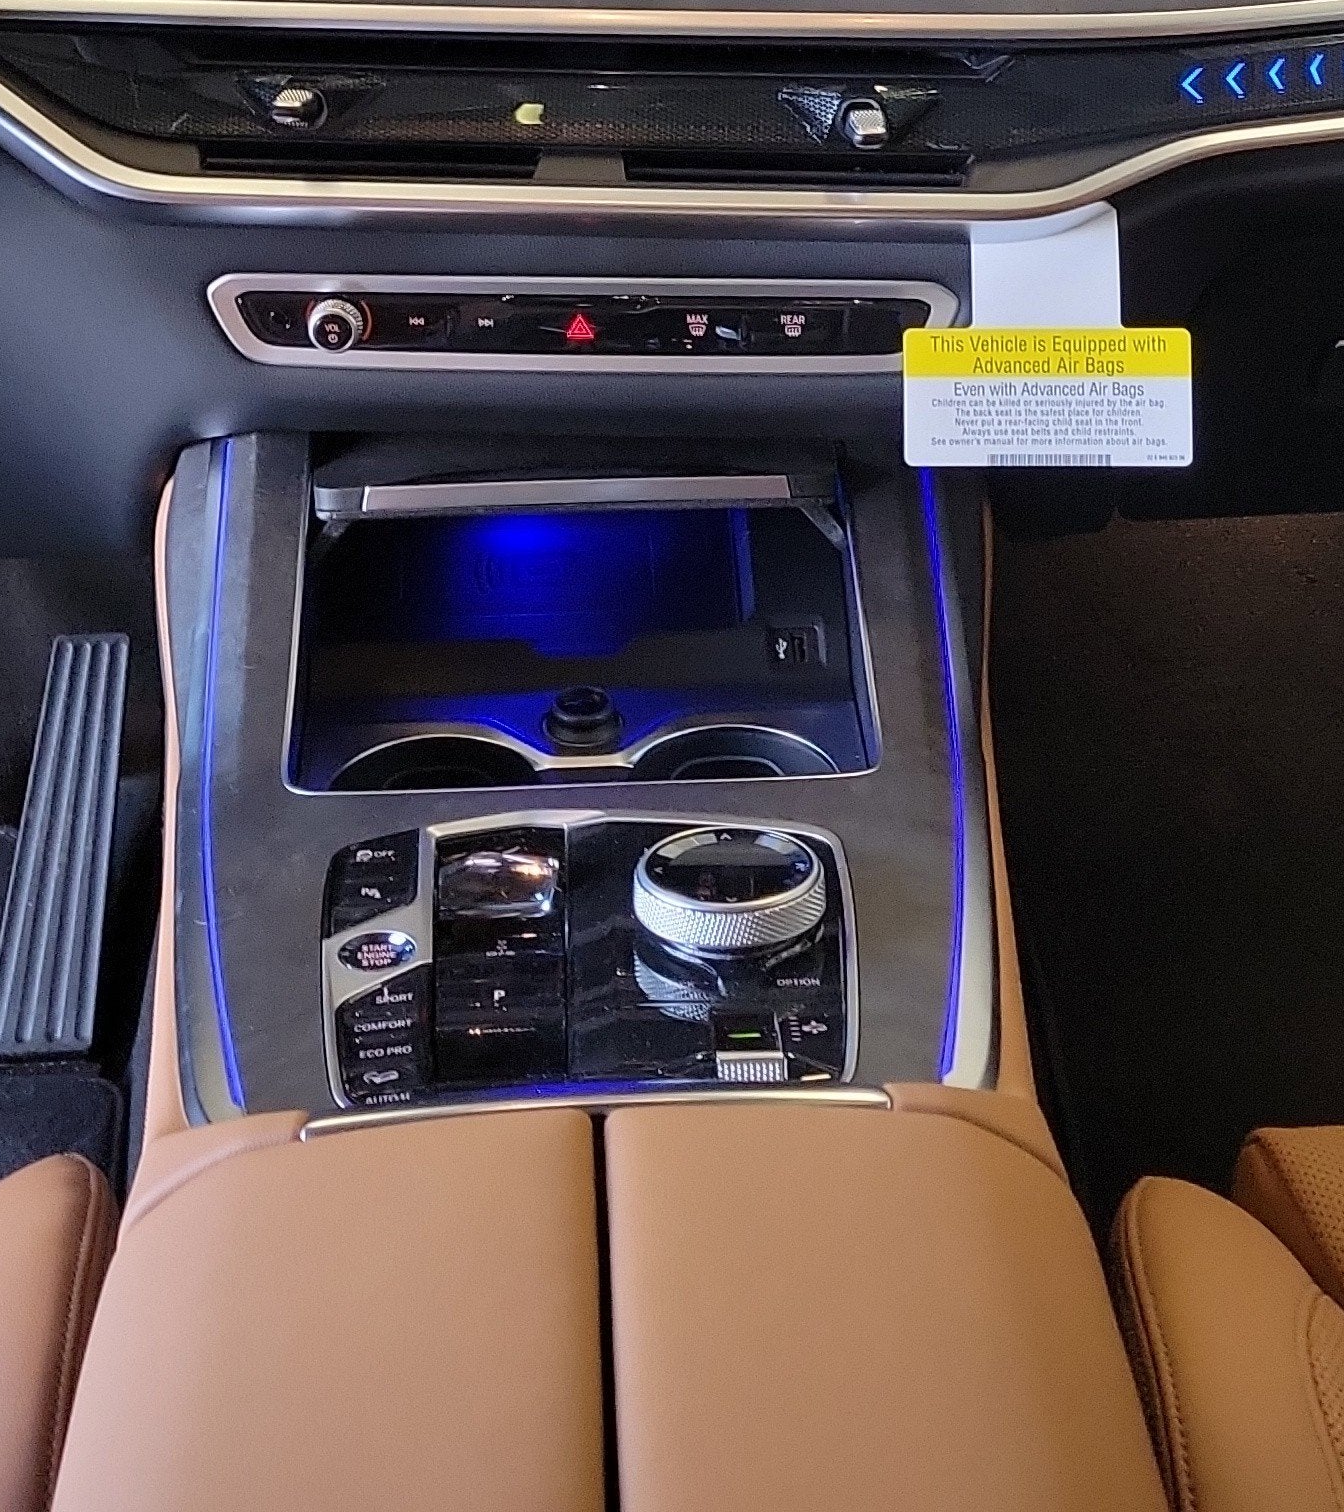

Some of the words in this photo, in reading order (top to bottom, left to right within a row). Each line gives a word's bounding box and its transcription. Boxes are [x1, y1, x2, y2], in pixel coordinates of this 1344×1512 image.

[686, 313, 709, 325] MAX
[780, 314, 806, 325] REAR
[324, 322, 341, 333] VOL
[930, 335, 964, 353] This
[969, 335, 1027, 353] Vehicle
[1033, 335, 1046, 353] is
[1052, 335, 1127, 356] Equipped
[1133, 335, 1167, 353] with
[972, 356, 1051, 374] Advanced
[1056, 356, 1080, 374] Air
[1085, 356, 1125, 377] Bags
[953, 381, 986, 397] Even
[989, 381, 1017, 397] with
[1021, 381, 1085, 397] Advanced
[1089, 381, 1108, 397] Air
[1112, 381, 1145, 399] Bags
[931, 398, 967, 407] Children
[968, 398, 984, 407] can
[986, 398, 997, 407] be
[999, 398, 1021, 407] killed
[1023, 398, 1033, 407] or
[1035, 398, 1073, 408] seriously
[1075, 398, 1105, 408] injured
[1107, 398, 1117, 409] by
[1119, 398, 1133, 407] the
[1135, 398, 1146, 407] air
[955, 408, 971, 417] The
[973, 408, 993, 417] back
[995, 408, 1012, 417] seat
[1014, 408, 1022, 417] is
[1024, 408, 1038, 417] the
[1040, 408, 1065, 417] safest
[1067, 408, 1090, 418] place
[1092, 408, 1104, 417] for
[955, 418, 978, 426] Never
[980, 418, 995, 428] put
[1004, 418, 1050, 428] rear-facing
[1052, 418, 1073, 426] child
[1075, 418, 1093, 426] seat
[1094, 418, 1103, 426] in
[1105, 418, 1119, 426] the
[962, 428, 991, 438] Always
[1011, 428, 1028, 436] seat
[1031, 428, 1051, 436] belts
[1053, 428, 1069, 436] and
[1071, 428, 1092, 436] child
[931, 437, 947, 446] See
[948, 437, 981, 446] owner's
[983, 437, 1014, 446] manual
[1016, 437, 1028, 446] for
[1030, 437, 1053, 446] more
[1055, 437, 1104, 446] information
[1105, 437, 1130, 446] about
[1131, 437, 1143, 446] air
[361, 944, 392, 952] START
[356, 951, 397, 960] ENGINE
[361, 958, 392, 967] STOP
[776, 977, 821, 987] OPTION
[375, 991, 414, 1005] SPORT
[493, 989, 506, 1001] P
[354, 1018, 413, 1033] COMFORT
[359, 1048, 385, 1059] ECO
[387, 1045, 413, 1056] PRO
